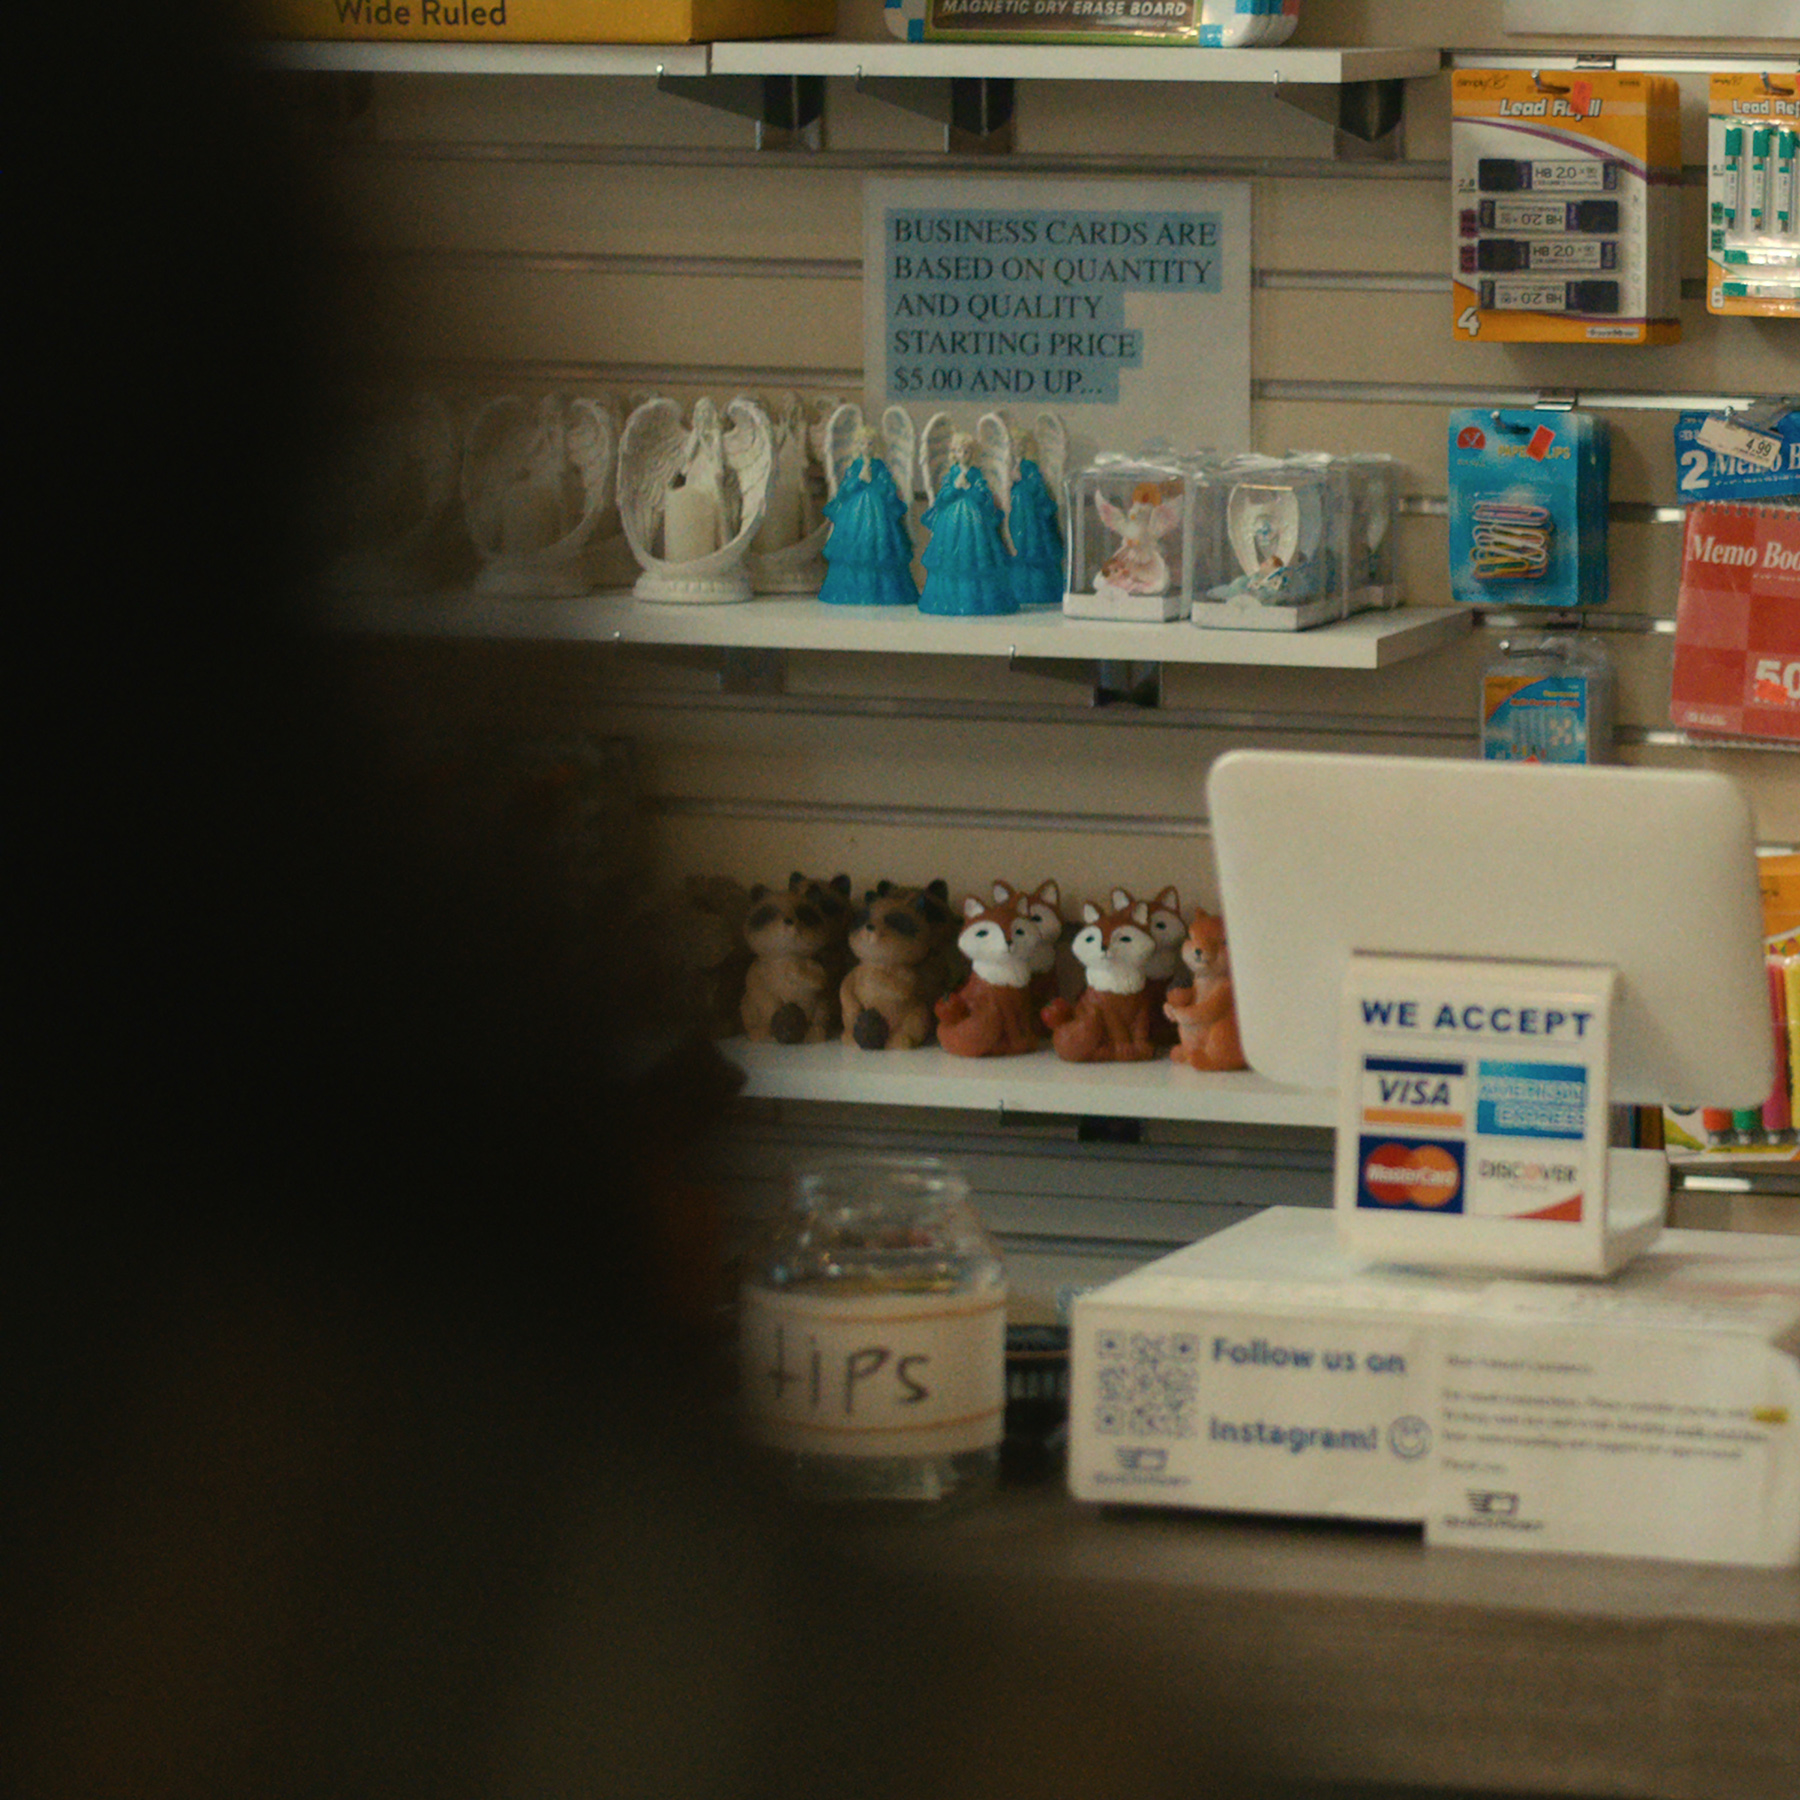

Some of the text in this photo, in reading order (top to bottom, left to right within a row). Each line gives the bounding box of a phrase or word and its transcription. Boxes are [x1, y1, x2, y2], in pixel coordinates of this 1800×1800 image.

[336, 0, 507, 26] Wide Ruled
[1033, 0, 1065, 15] DRY
[1072, 0, 1124, 16] ERASE
[1129, 1, 1187, 17] BOARD
[1500, 98, 1549, 117] Lead
[1731, 100, 1771, 116] Lead
[1457, 307, 1481, 336] 4
[1497, 445, 1572, 460] PAPE LIPS
[1746, 438, 1773, 457] 4.99
[1679, 449, 1710, 491] 2
[1689, 533, 1759, 567] Memo
[1362, 999, 1593, 1037] WE ACCEPT
[1379, 1077, 1452, 1106] VISA
[1367, 1162, 1459, 1188] MasterCard
[1211, 1335, 1408, 1375] Follow us on
[1209, 1415, 1379, 1455] Instagram!
